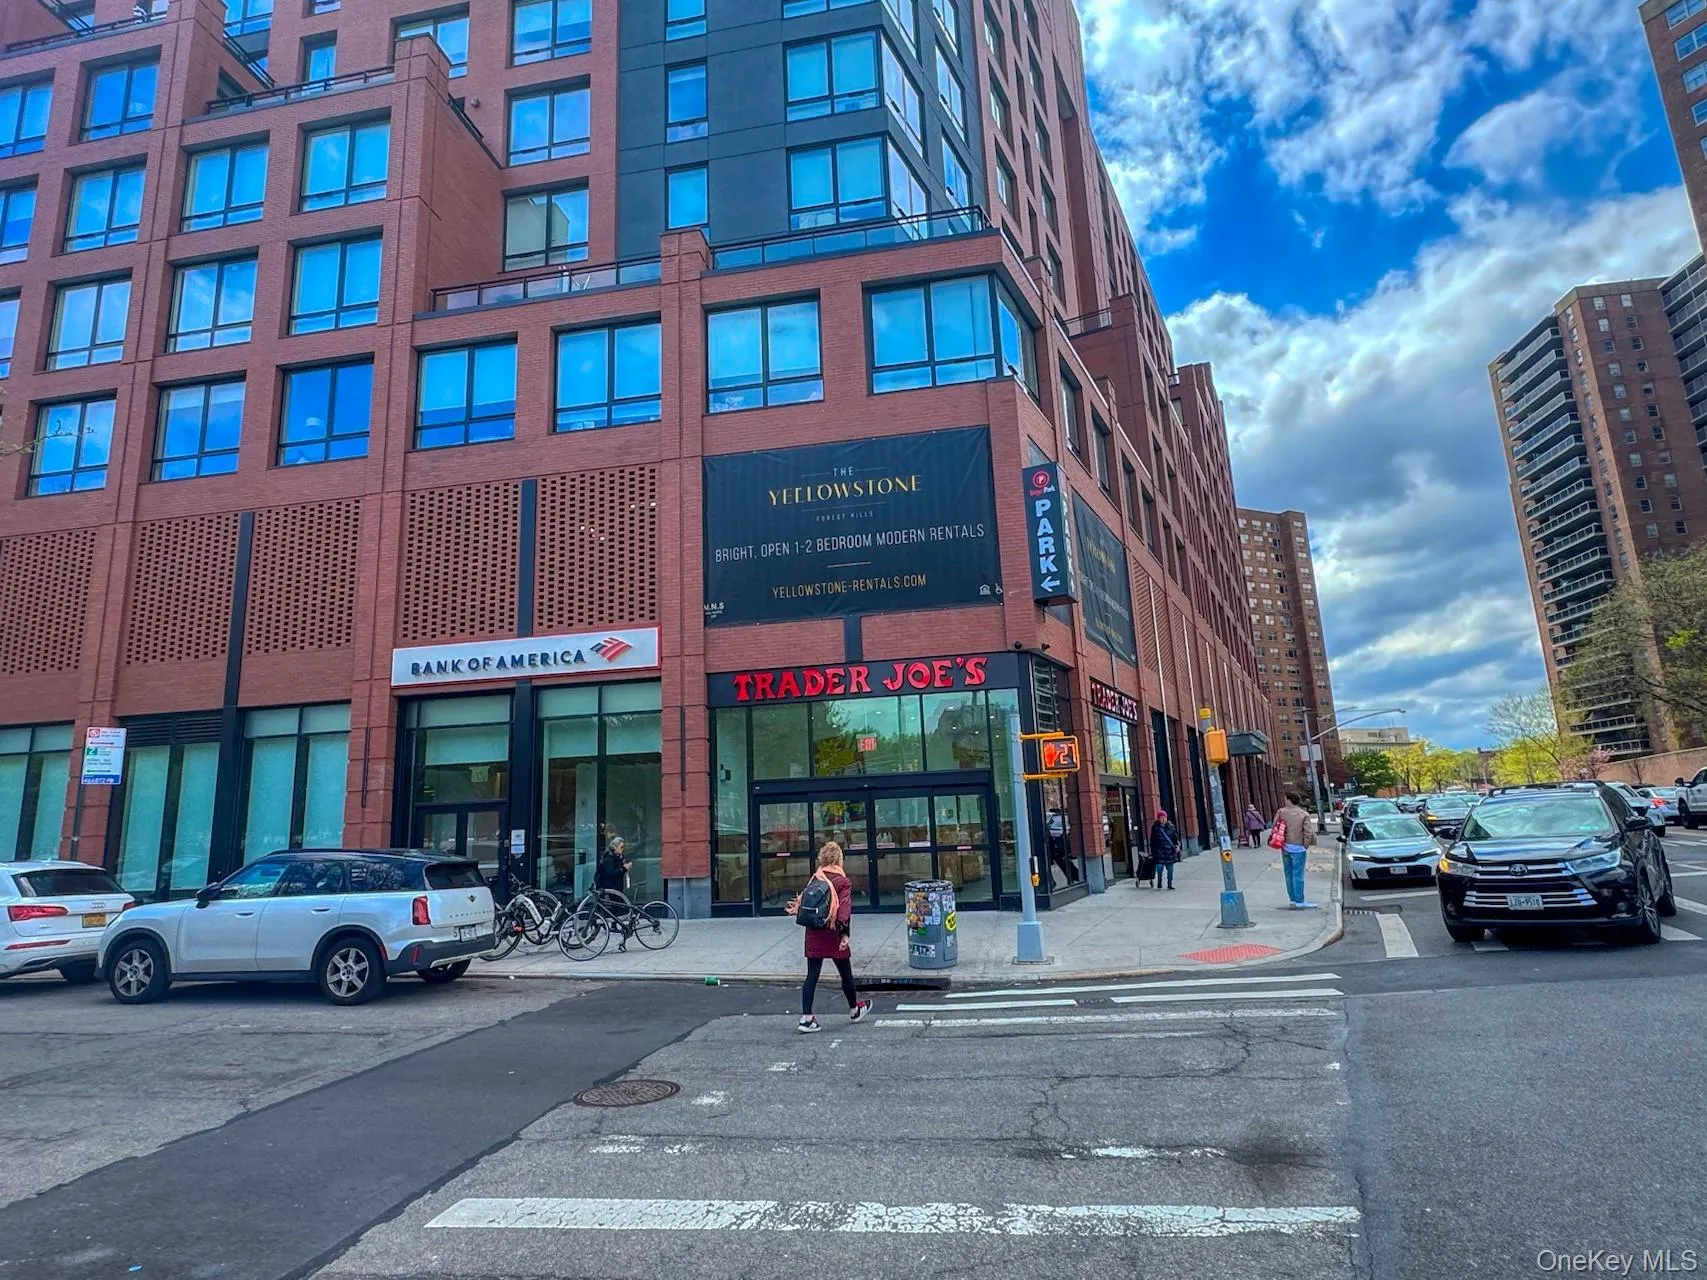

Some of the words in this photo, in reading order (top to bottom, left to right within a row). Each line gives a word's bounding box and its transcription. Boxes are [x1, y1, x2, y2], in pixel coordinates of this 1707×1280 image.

[833, 466, 854, 477] THE
[768, 474, 923, 506] YELLOWSTONE
[761, 542, 790, 558] OPEN
[795, 540, 812, 554] 1-2
[816, 533, 872, 552] BEDROOM
[876, 528, 925, 546] MODERN
[930, 523, 985, 541] RENTALS
[1035, 499, 1058, 574] PARK
[772, 574, 927, 599] YELLOWSTONE-RENTALS.COM
[411, 658, 462, 675] BANK
[468, 656, 491, 671] OF
[496, 649, 588, 669] AMERICA
[733, 664, 872, 702] TRADER
[882, 656, 989, 691] JOE'S
[1060, 743, 1076, 764] 27
